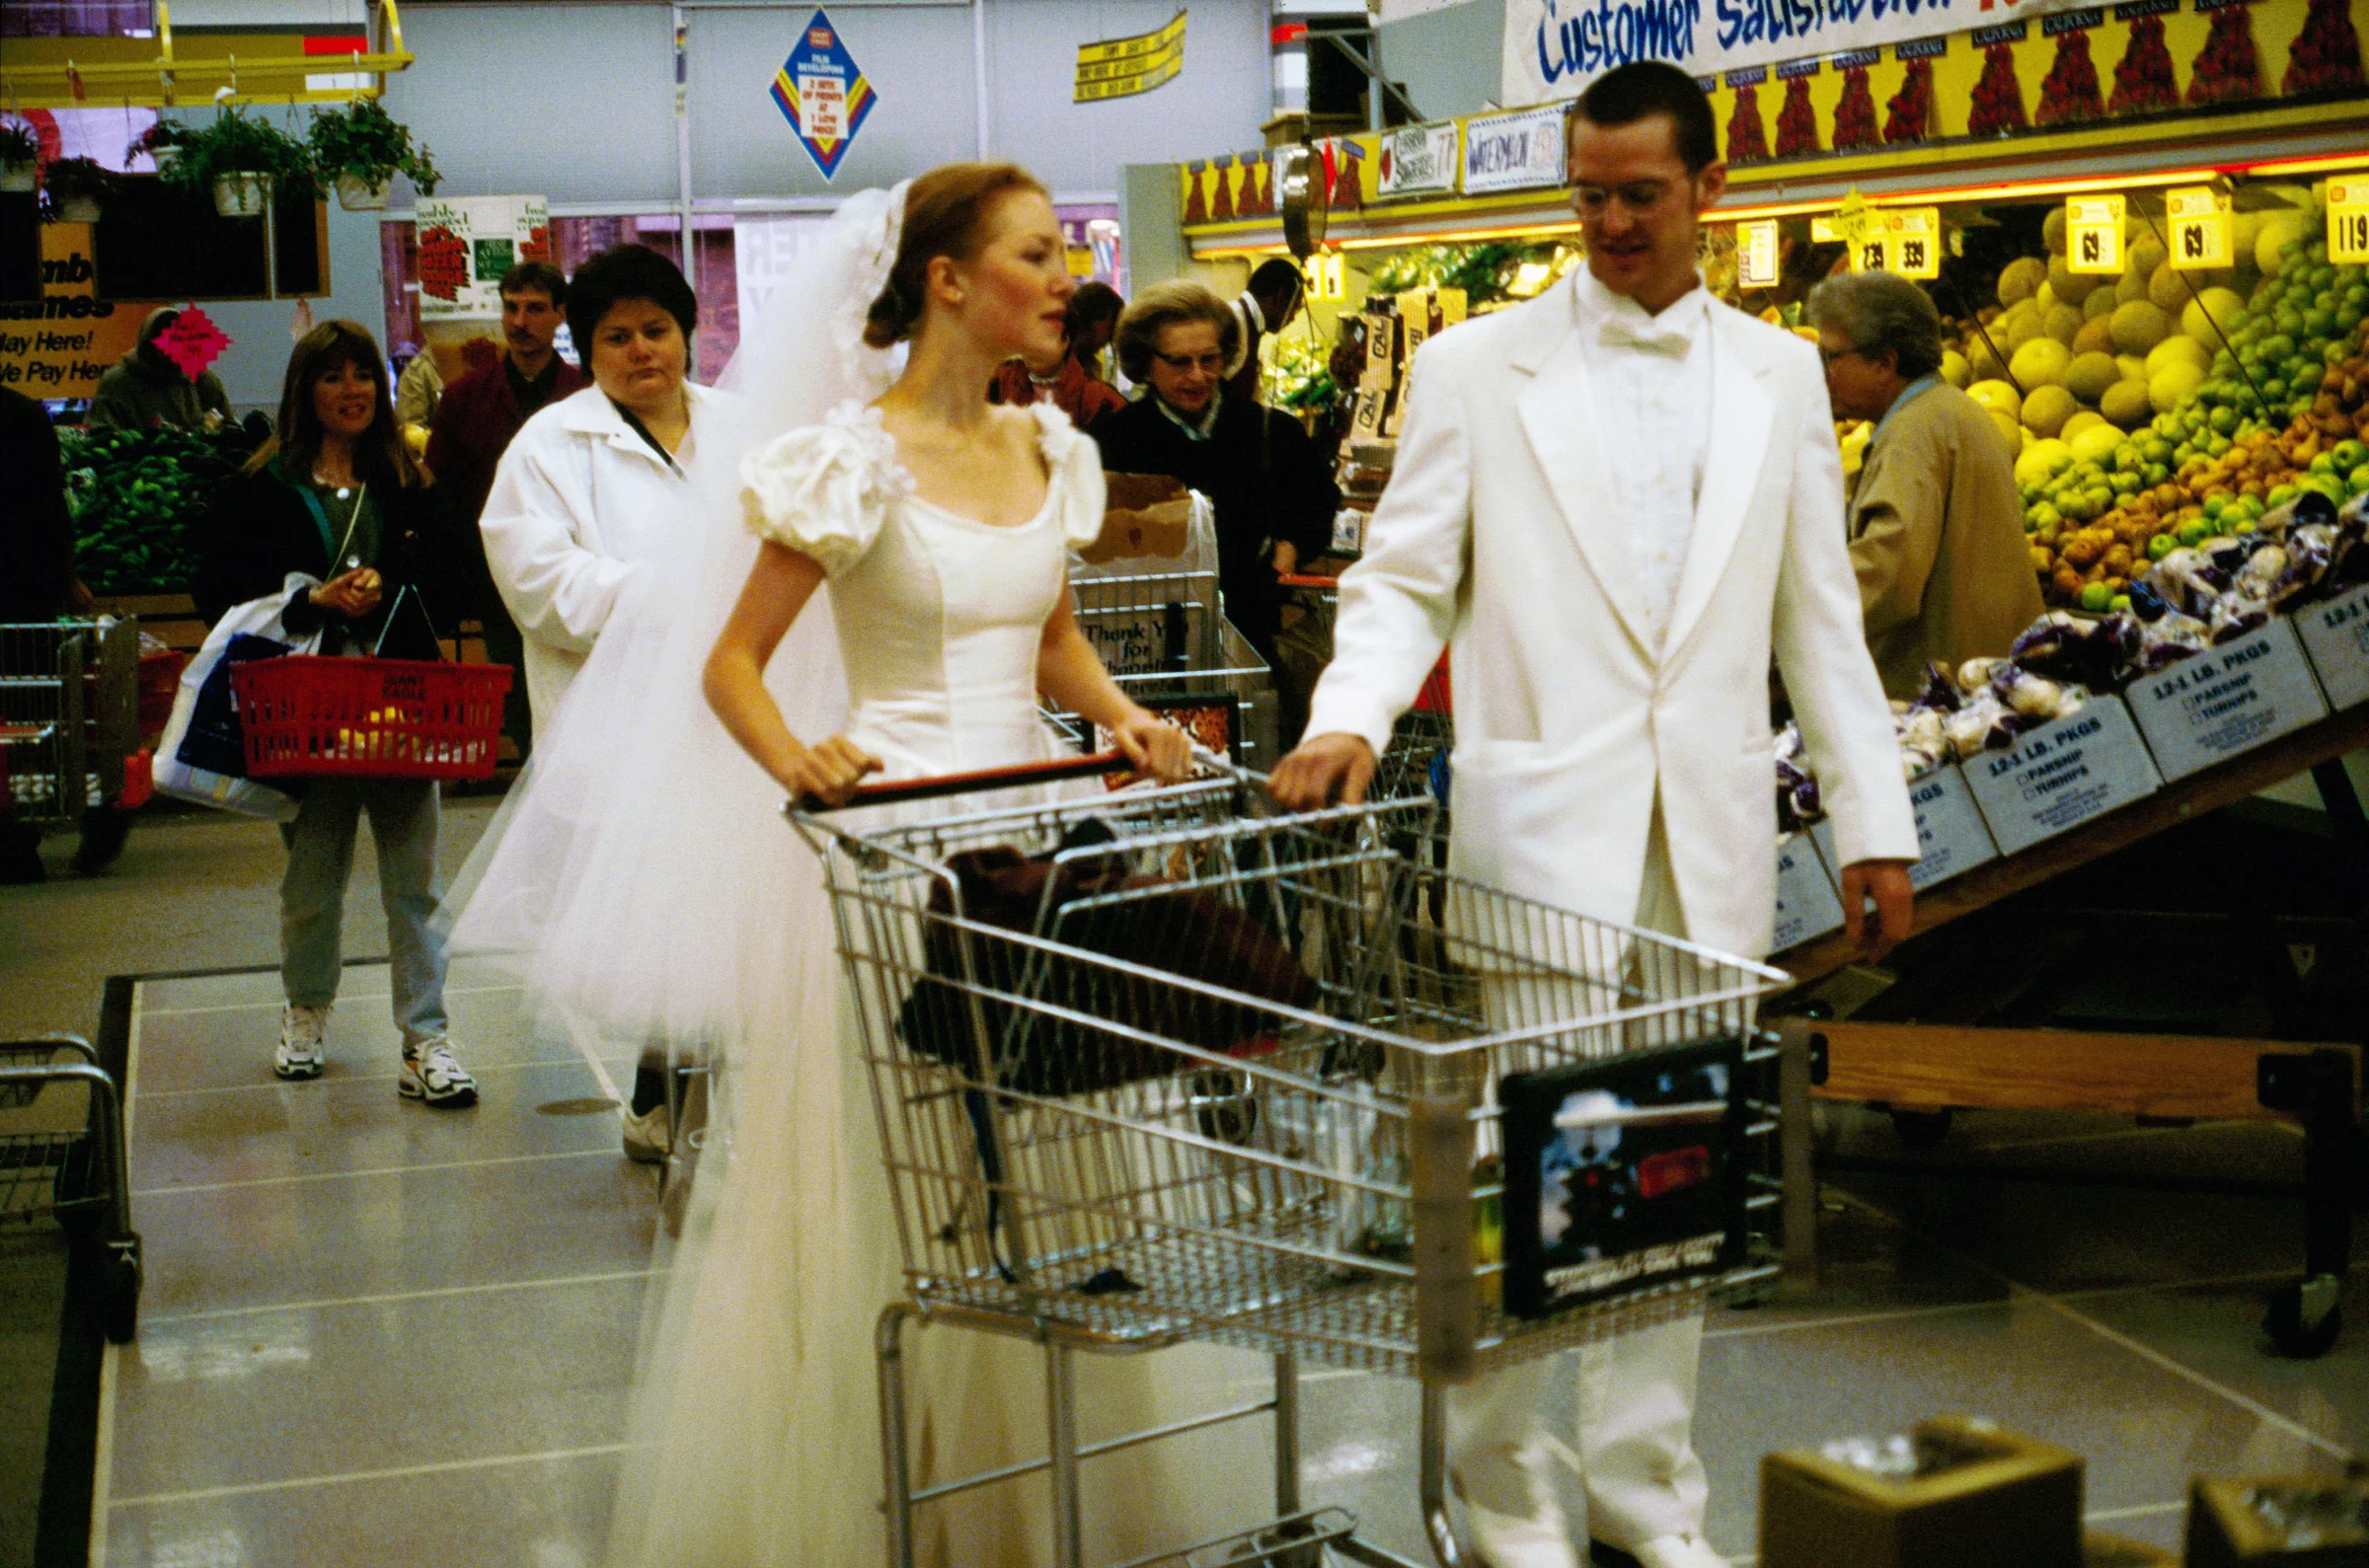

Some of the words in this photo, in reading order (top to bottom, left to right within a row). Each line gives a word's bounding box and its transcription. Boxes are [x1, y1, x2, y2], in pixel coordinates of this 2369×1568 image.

[1538, 0, 1700, 84] Customer
[1717, 0, 1952, 50] Satisfa
[2337, 214, 2368, 252] 119
[0, 333, 32, 356] lay
[36, 331, 93, 350] Here!
[27, 361, 65, 385] Pay
[70, 361, 109, 380] Her
[2191, 662, 2220, 683] LB.
[2223, 639, 2270, 670] PKGS
[1988, 752, 2022, 778] 12-1
[2025, 740, 2053, 760] LB.
[2054, 716, 2102, 746] PKGS
[2027, 748, 2083, 781] PARSNIP
[2035, 765, 2089, 795] TURNIPS
[1911, 783, 1944, 806] KGS
